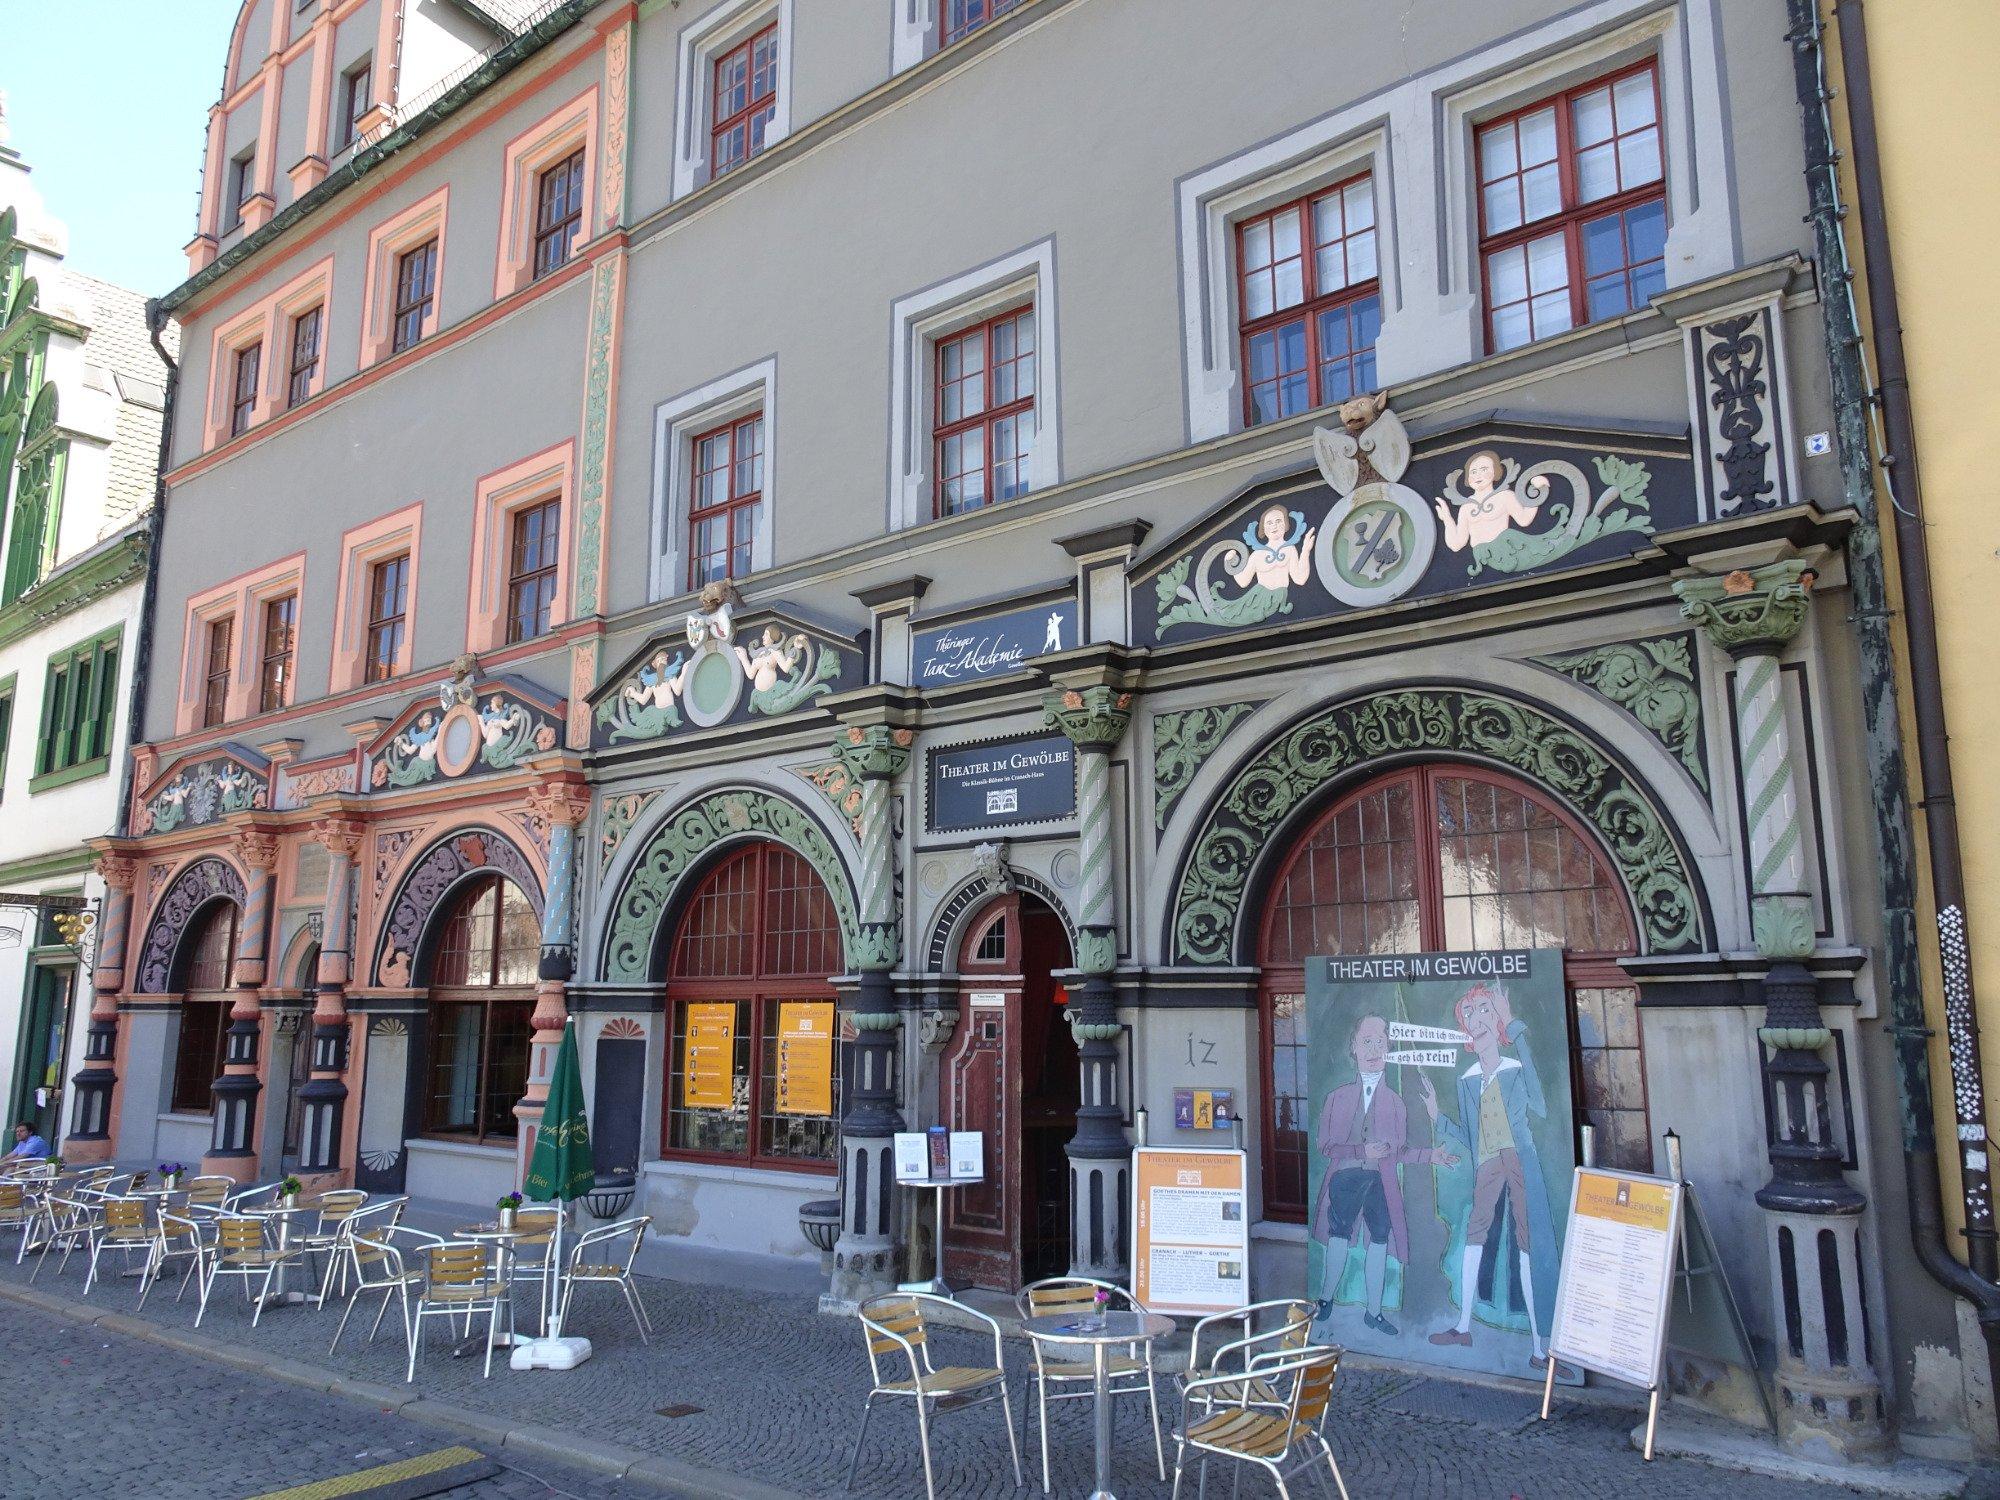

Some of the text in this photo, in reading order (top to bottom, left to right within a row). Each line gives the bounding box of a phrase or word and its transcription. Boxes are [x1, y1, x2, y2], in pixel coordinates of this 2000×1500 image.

[923, 634, 1024, 678] Tanz-Akademie
[936, 630, 975, 658] Thüringer
[940, 750, 1069, 779] THEATER IM GEWÖLBE
[1330, 953, 1528, 979] THEATER IM GEWÖLBE
[1390, 1024, 1415, 1039] Hier
[1419, 1028, 1434, 1039] bin
[1435, 1030, 1446, 1040] ich
[1412, 1052, 1424, 1064] ich
[1426, 1051, 1455, 1064] rein!
